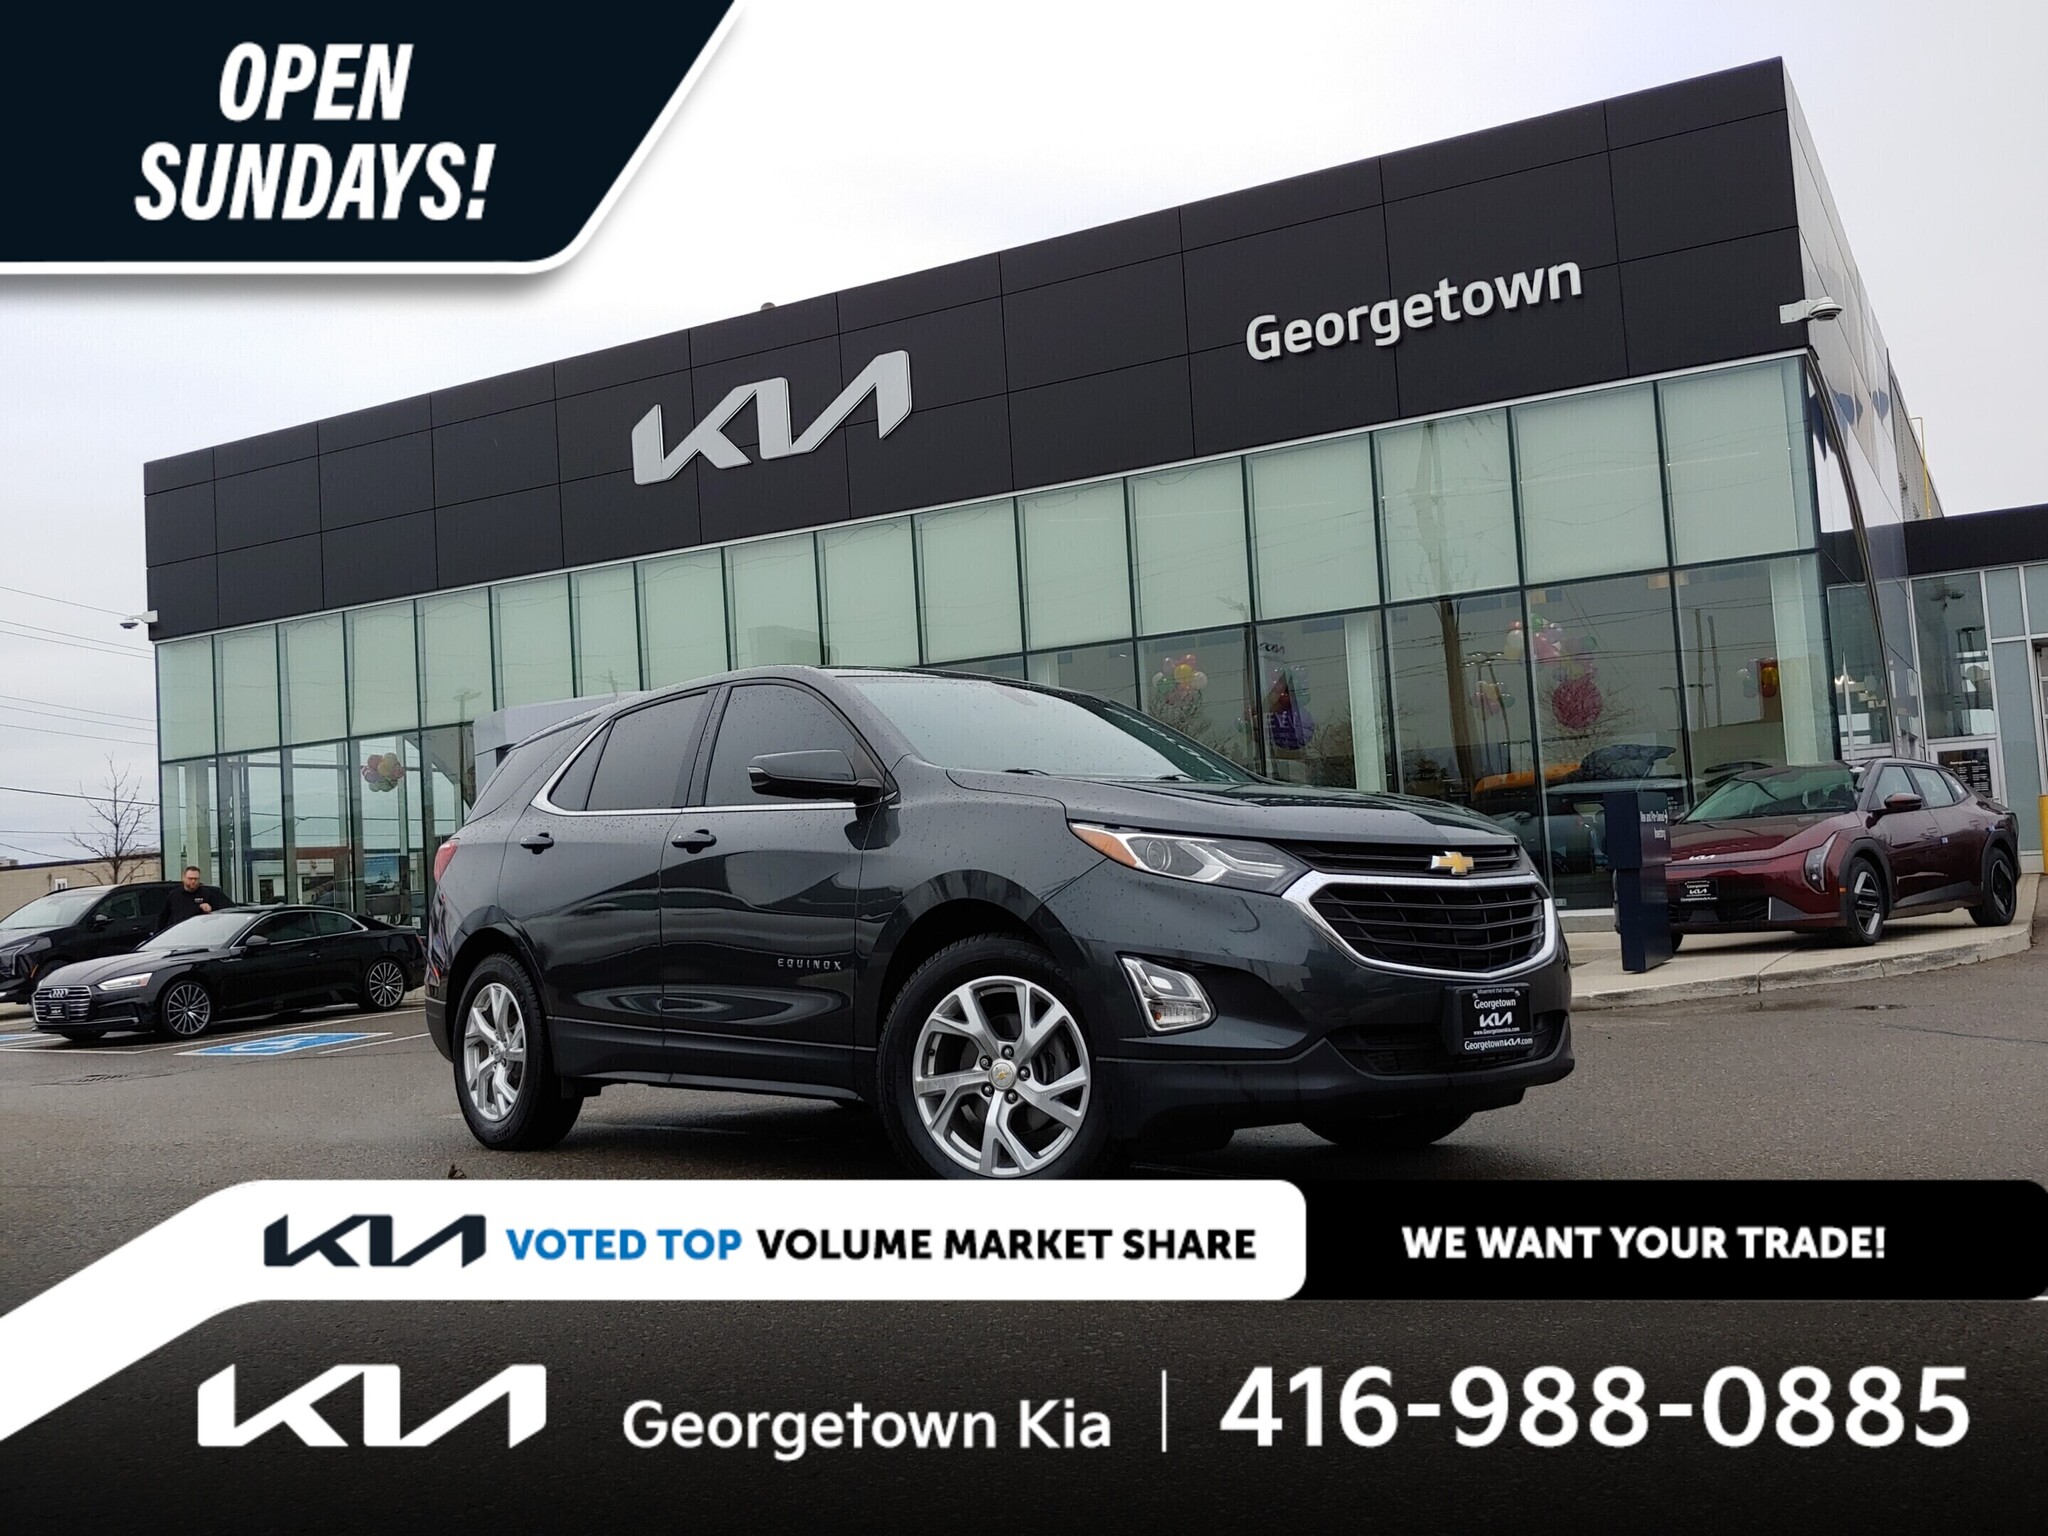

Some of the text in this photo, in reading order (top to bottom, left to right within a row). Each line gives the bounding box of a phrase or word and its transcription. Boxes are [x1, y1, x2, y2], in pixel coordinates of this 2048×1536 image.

[1246, 260, 1583, 361] Georgetown
[631, 350, 912, 486] KIA
[777, 958, 842, 971] EQUINOX
[1474, 999, 1516, 1010] Georgetown
[1479, 1011, 1512, 1027] KIA
